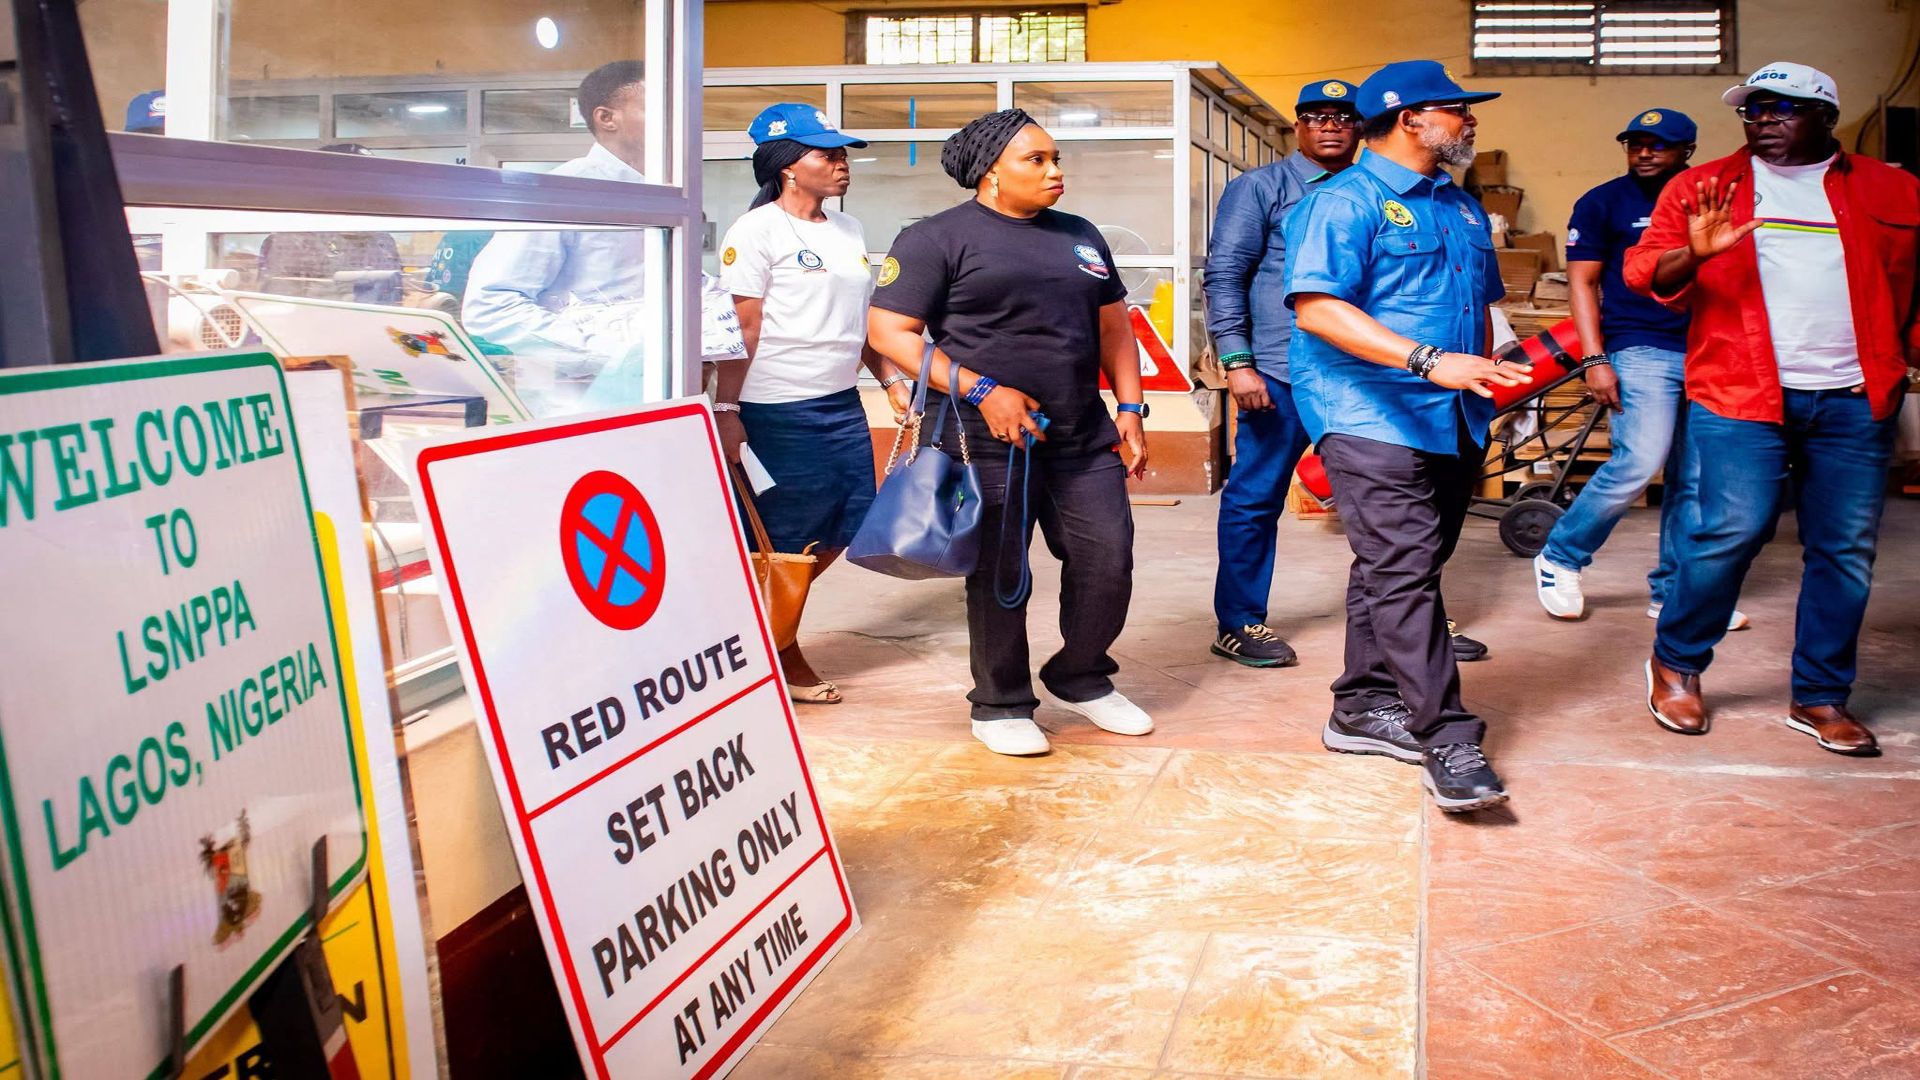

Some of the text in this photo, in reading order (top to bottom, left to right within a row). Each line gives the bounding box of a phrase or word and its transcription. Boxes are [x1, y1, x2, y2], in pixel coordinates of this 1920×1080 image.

[1750, 72, 1788, 84] LAGOS
[145, 508, 198, 575] TO
[117, 580, 256, 694] LSNPPA
[540, 634, 748, 770] RED ROUTE
[43, 642, 328, 870] LAGOS, NIGERIA
[607, 733, 756, 865] SET BACK
[591, 792, 802, 998] PARKING ONLY
[672, 903, 809, 1065] AT ANY TIME
